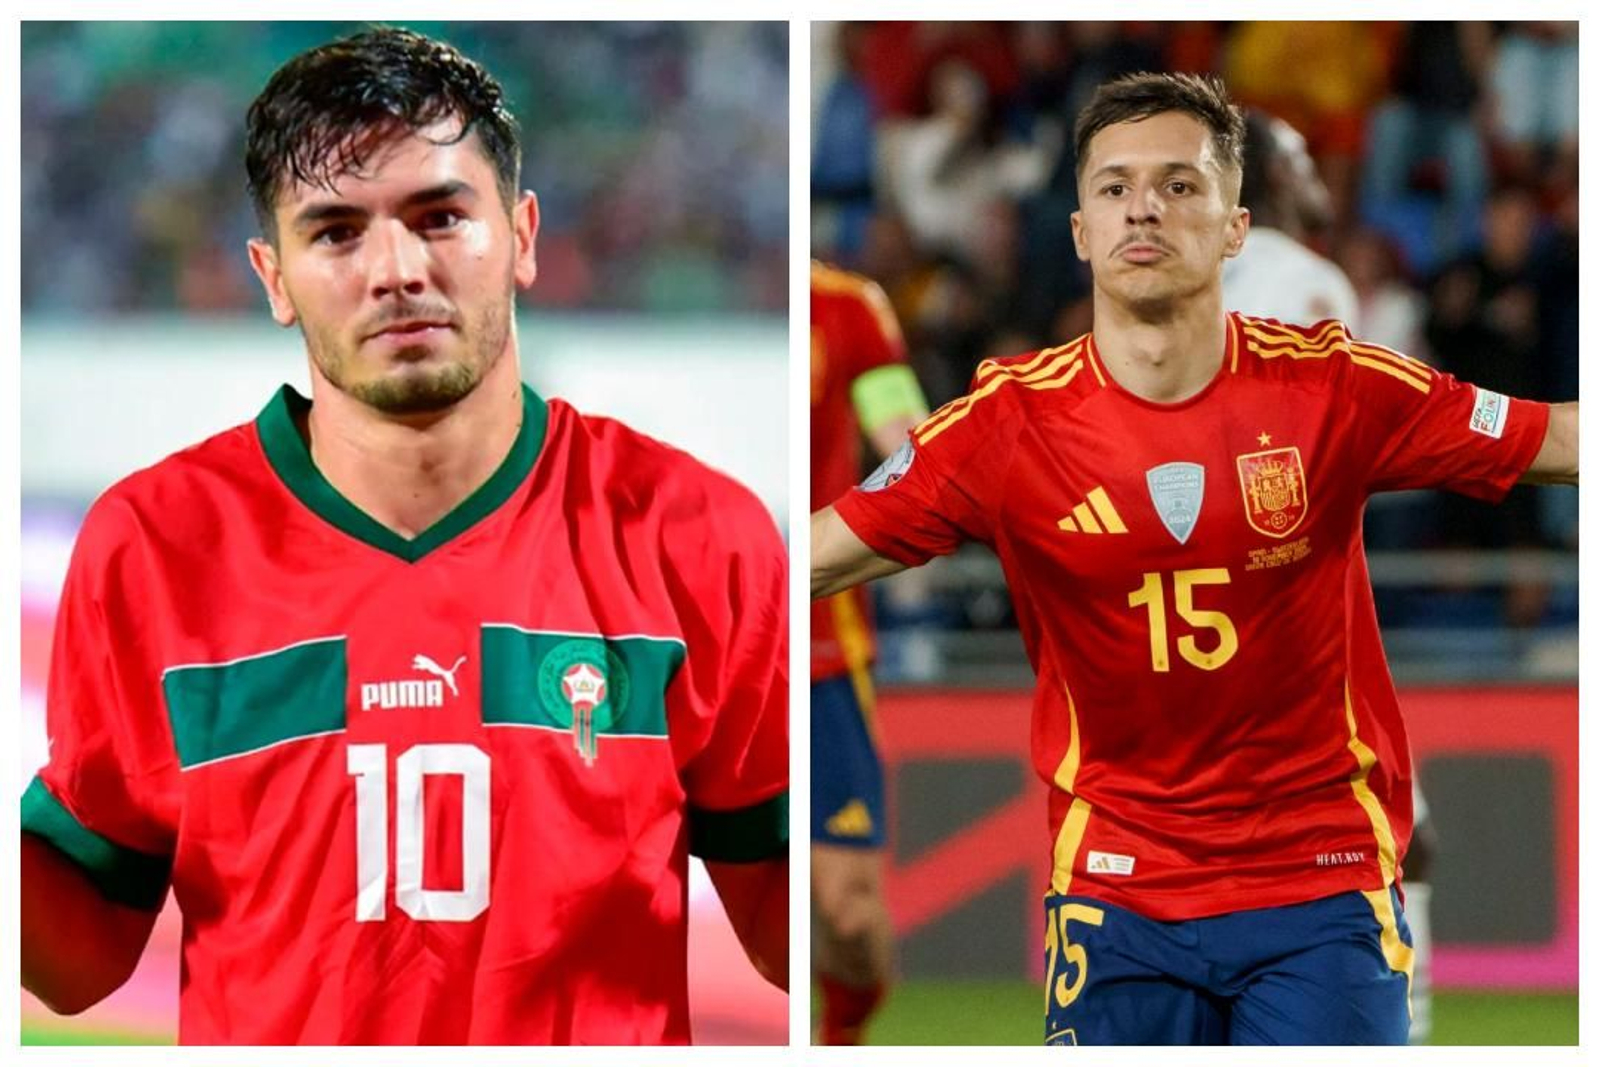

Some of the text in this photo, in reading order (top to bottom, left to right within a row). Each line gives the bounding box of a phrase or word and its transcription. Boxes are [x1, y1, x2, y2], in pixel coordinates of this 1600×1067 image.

[1127, 567, 1239, 672] 15
[361, 680, 444, 711] PUMA
[347, 743, 491, 922] 10
[1045, 903, 1105, 1016] 15
